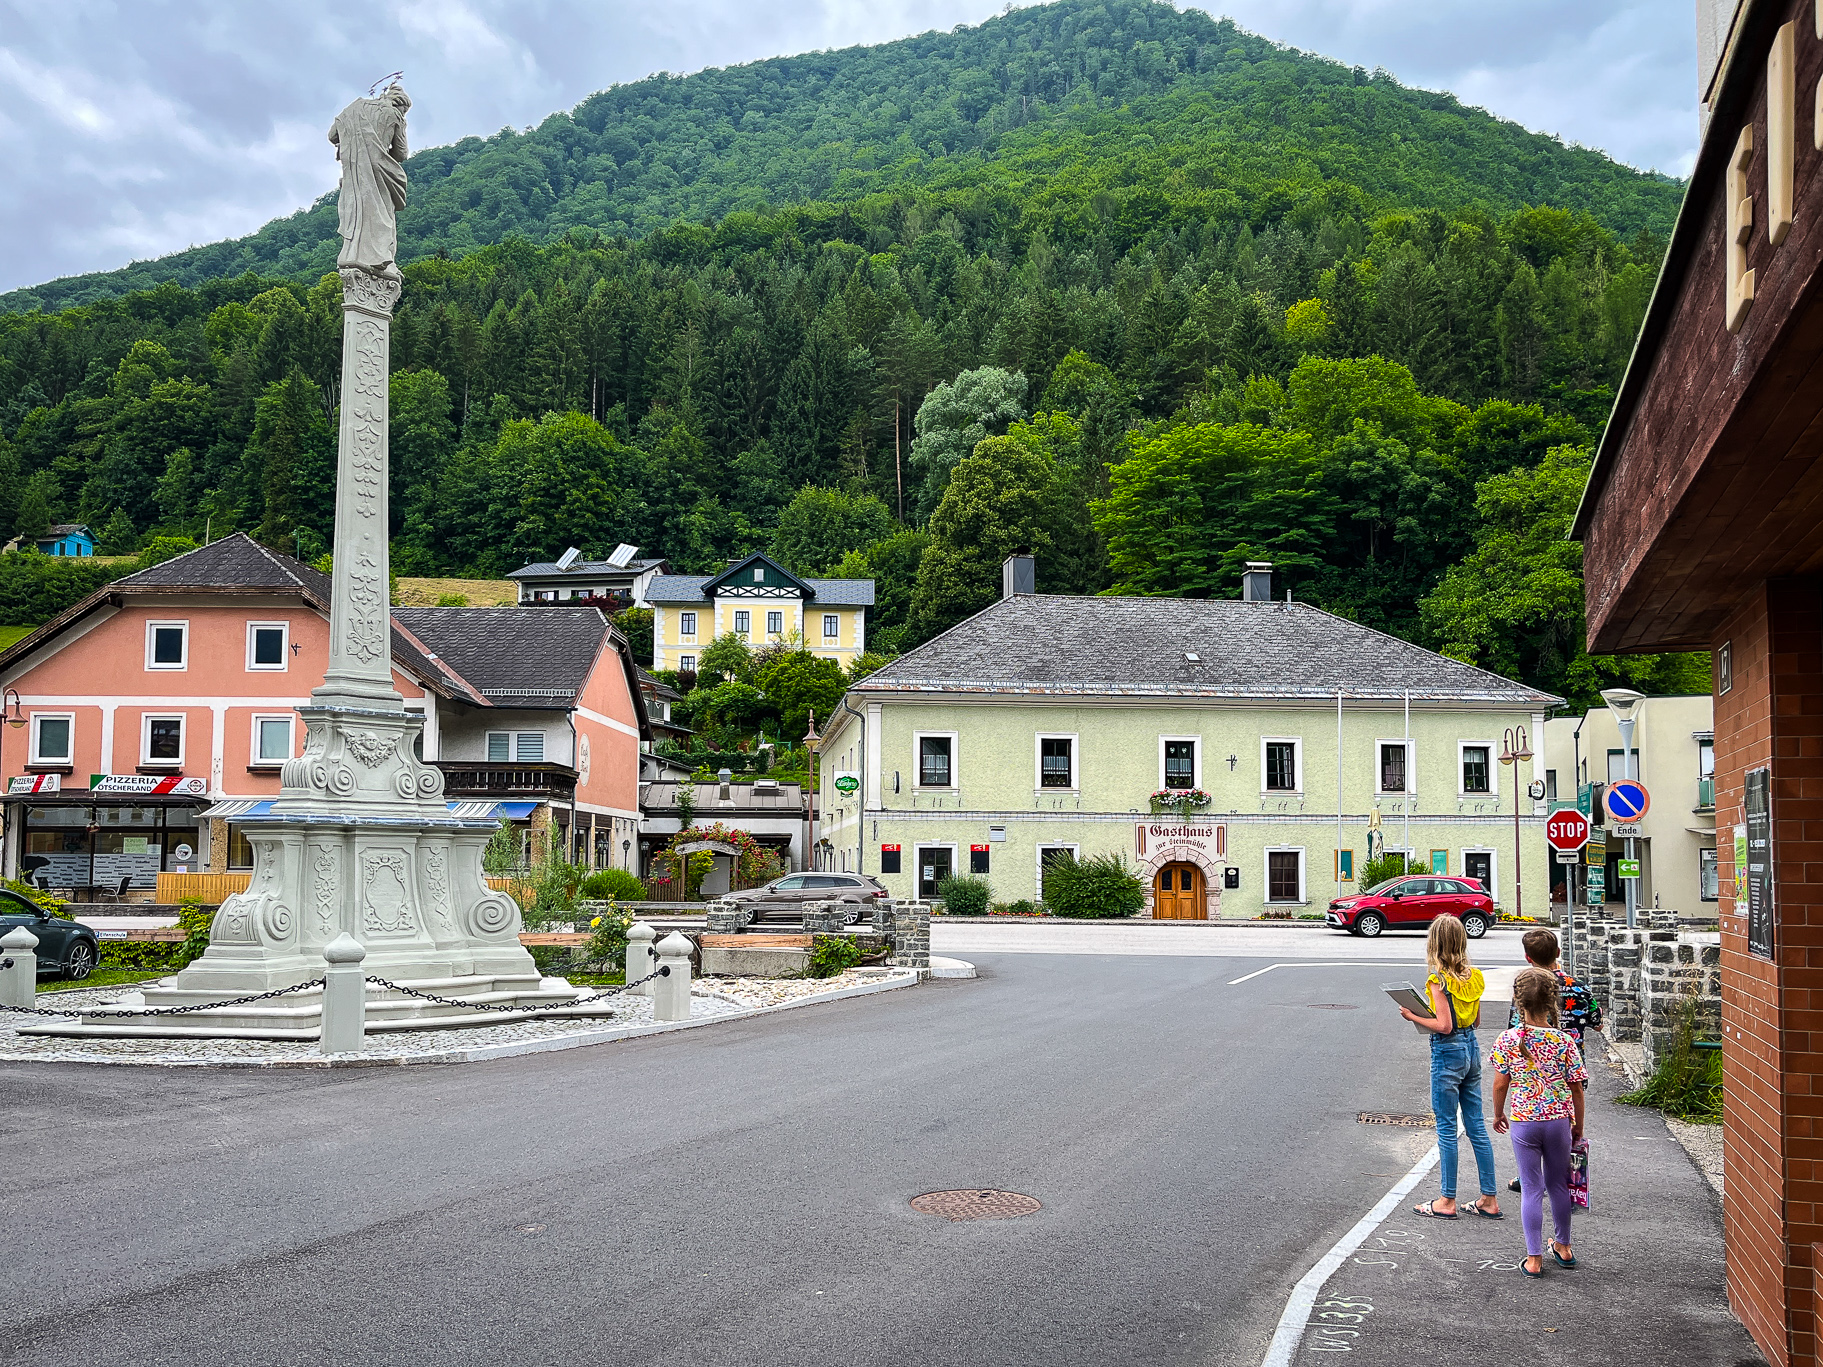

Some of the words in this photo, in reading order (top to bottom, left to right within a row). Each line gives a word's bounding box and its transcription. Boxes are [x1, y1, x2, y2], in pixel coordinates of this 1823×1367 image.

[13, 777, 35, 785] PIZZERIA
[105, 776, 158, 785] PIZZERIA
[1150, 825, 1212, 838] Gasthaus
[1549, 822, 1585, 838] STOP
[1617, 826, 1637, 835] Ende
